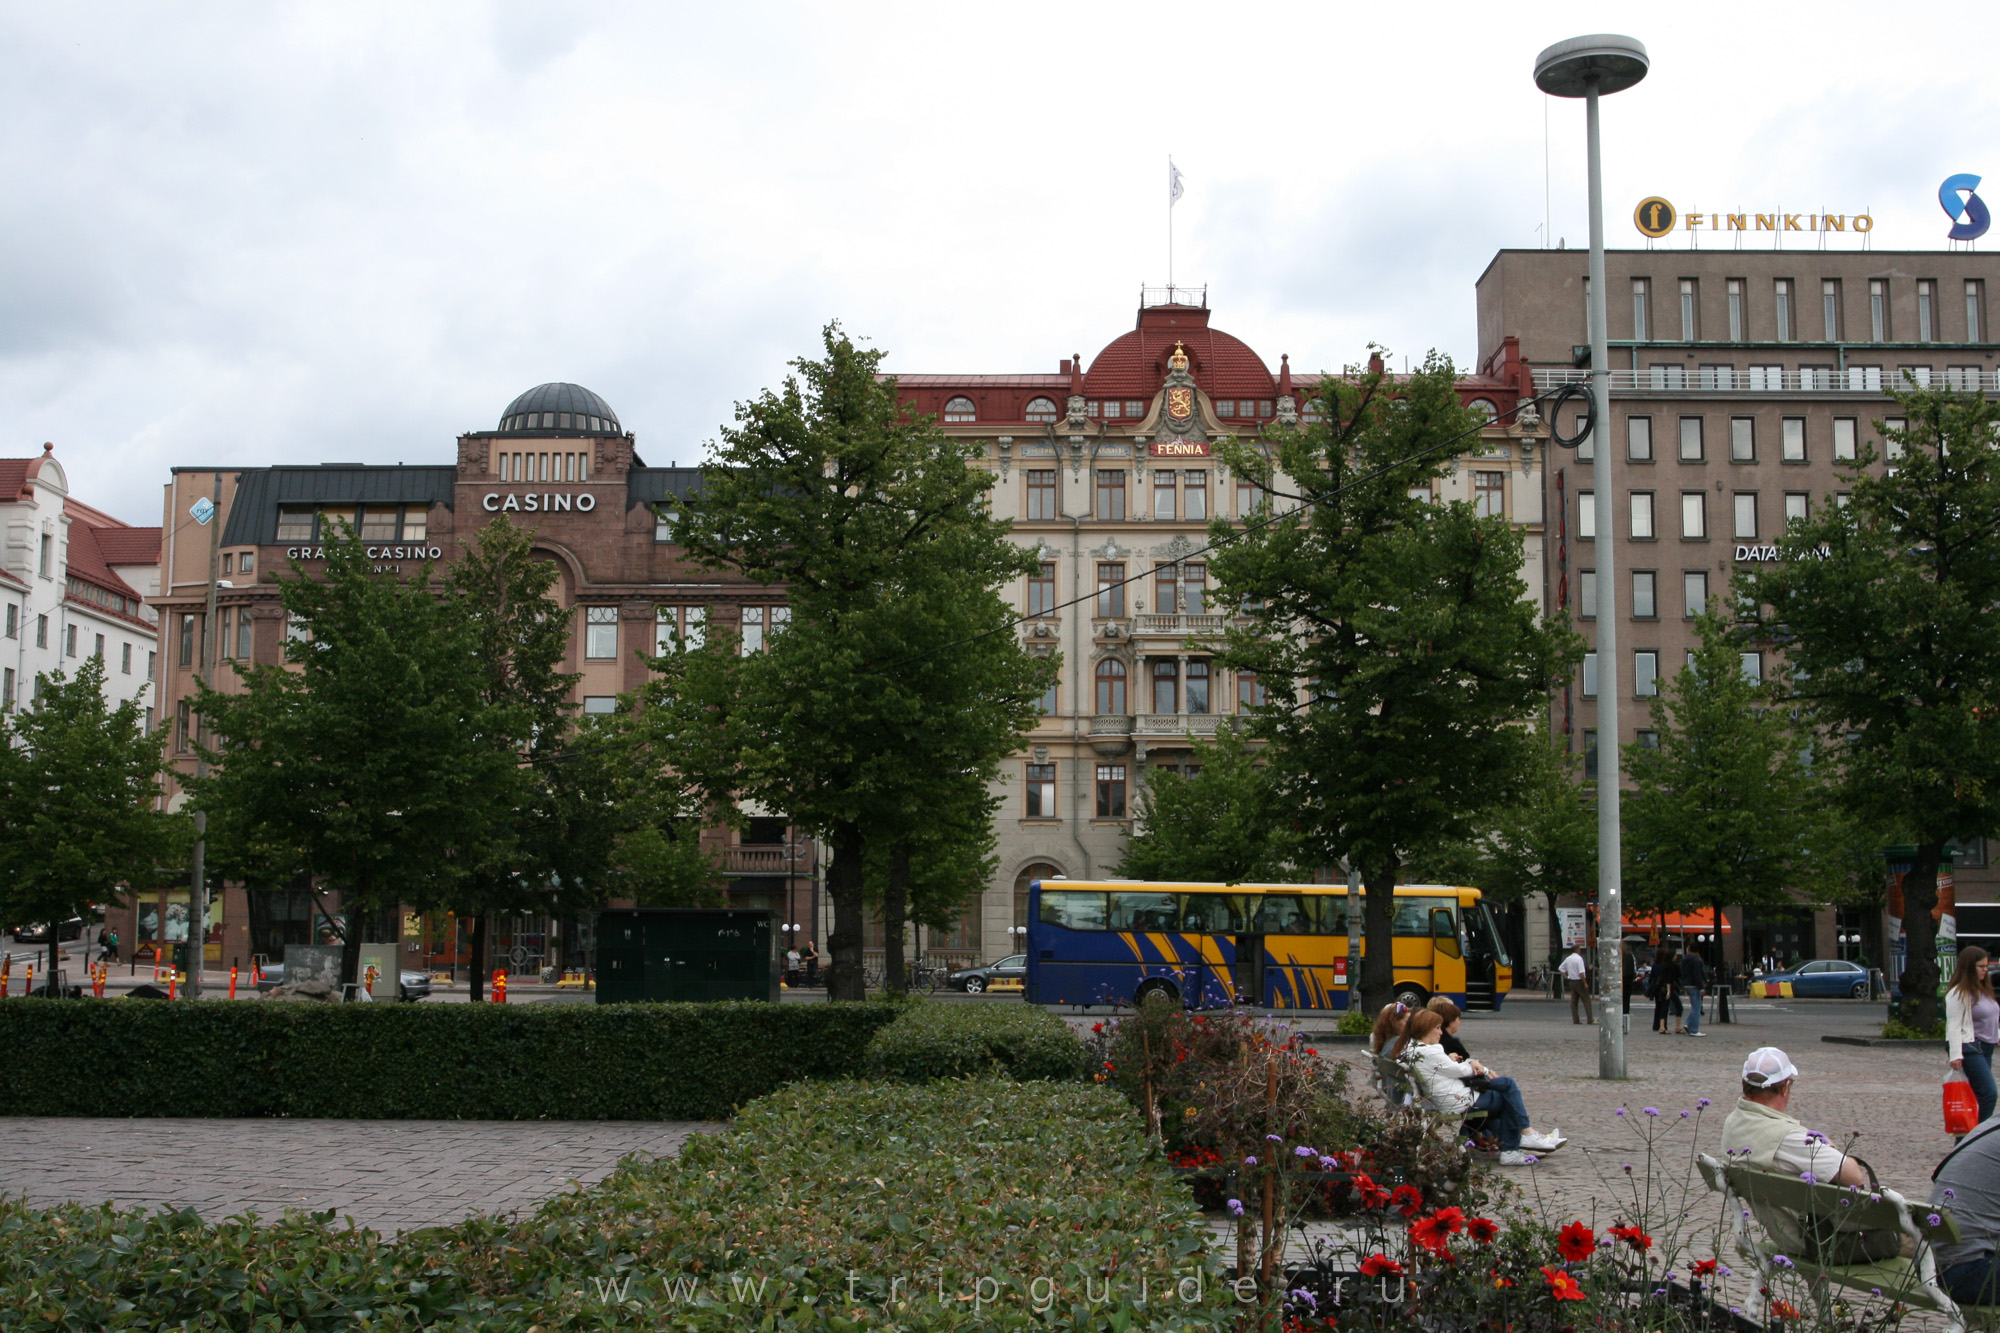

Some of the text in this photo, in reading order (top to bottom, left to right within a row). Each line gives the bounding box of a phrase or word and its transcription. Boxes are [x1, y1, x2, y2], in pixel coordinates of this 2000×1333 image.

[1685, 213, 1874, 232] FINNKINO
[1157, 444, 1203, 455] FENNIA
[483, 493, 595, 512] CASINO
[287, 547, 442, 559] GRA CASINO
[757, 920, 769, 928] WC
